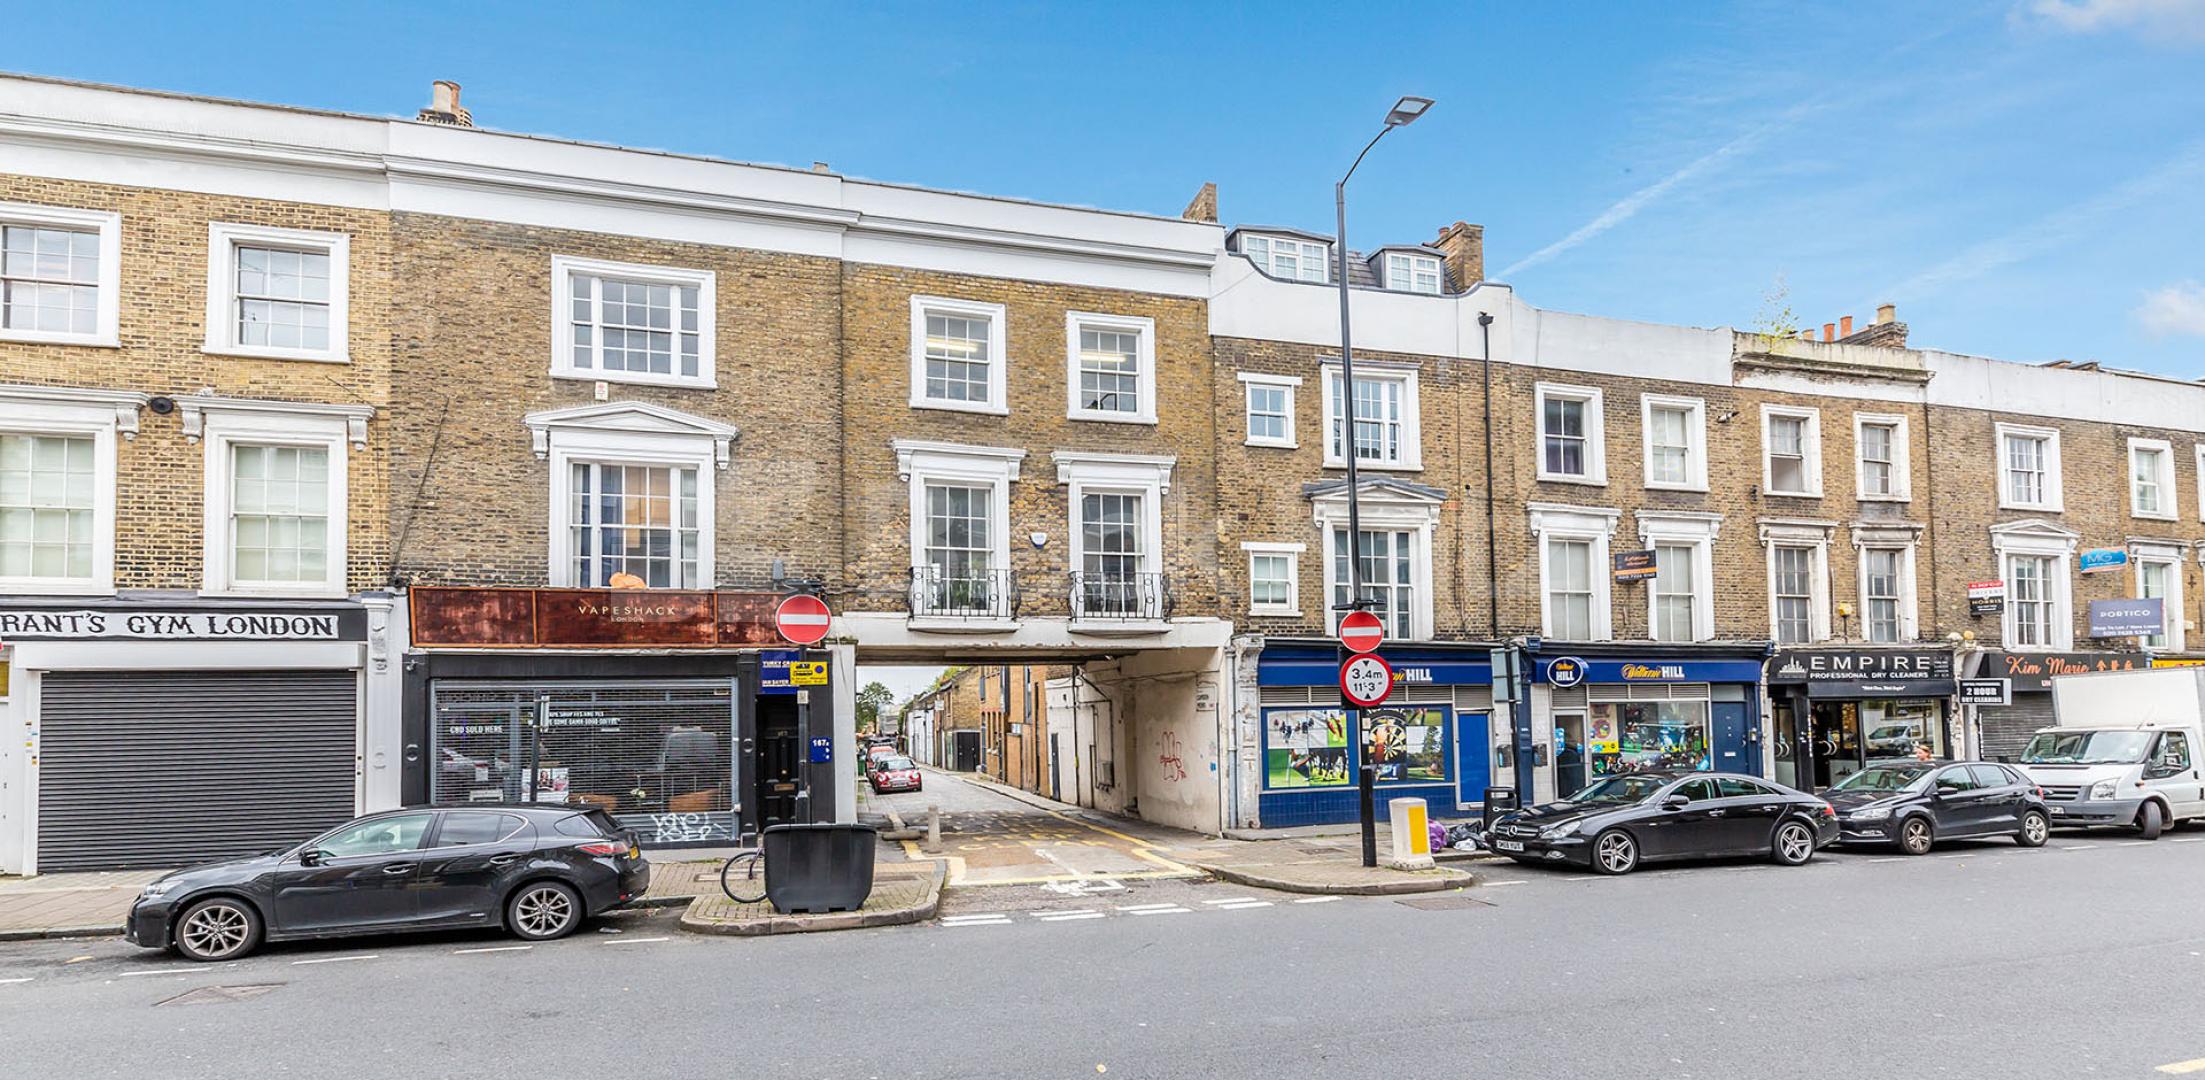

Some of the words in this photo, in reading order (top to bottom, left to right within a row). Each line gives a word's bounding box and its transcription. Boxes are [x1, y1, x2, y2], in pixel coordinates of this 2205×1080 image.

[2099, 609, 2151, 618] PORTICO
[127, 614, 194, 637] GYM
[208, 616, 334, 638] LONDON
[1810, 655, 1931, 671] EMPIRE
[2005, 655, 2042, 675] Kim
[2045, 656, 2090, 675] Marie
[1351, 668, 1383, 680] 3.4m
[1405, 667, 1433, 681] HILL
[1555, 670, 1575, 681] HILL
[1661, 665, 1686, 679] HILL
[1809, 671, 1868, 680] PROFESSIONAL
[1871, 671, 1886, 679] DRY
[1888, 671, 1929, 679] CLEANERS
[1966, 687, 1973, 696] 2
